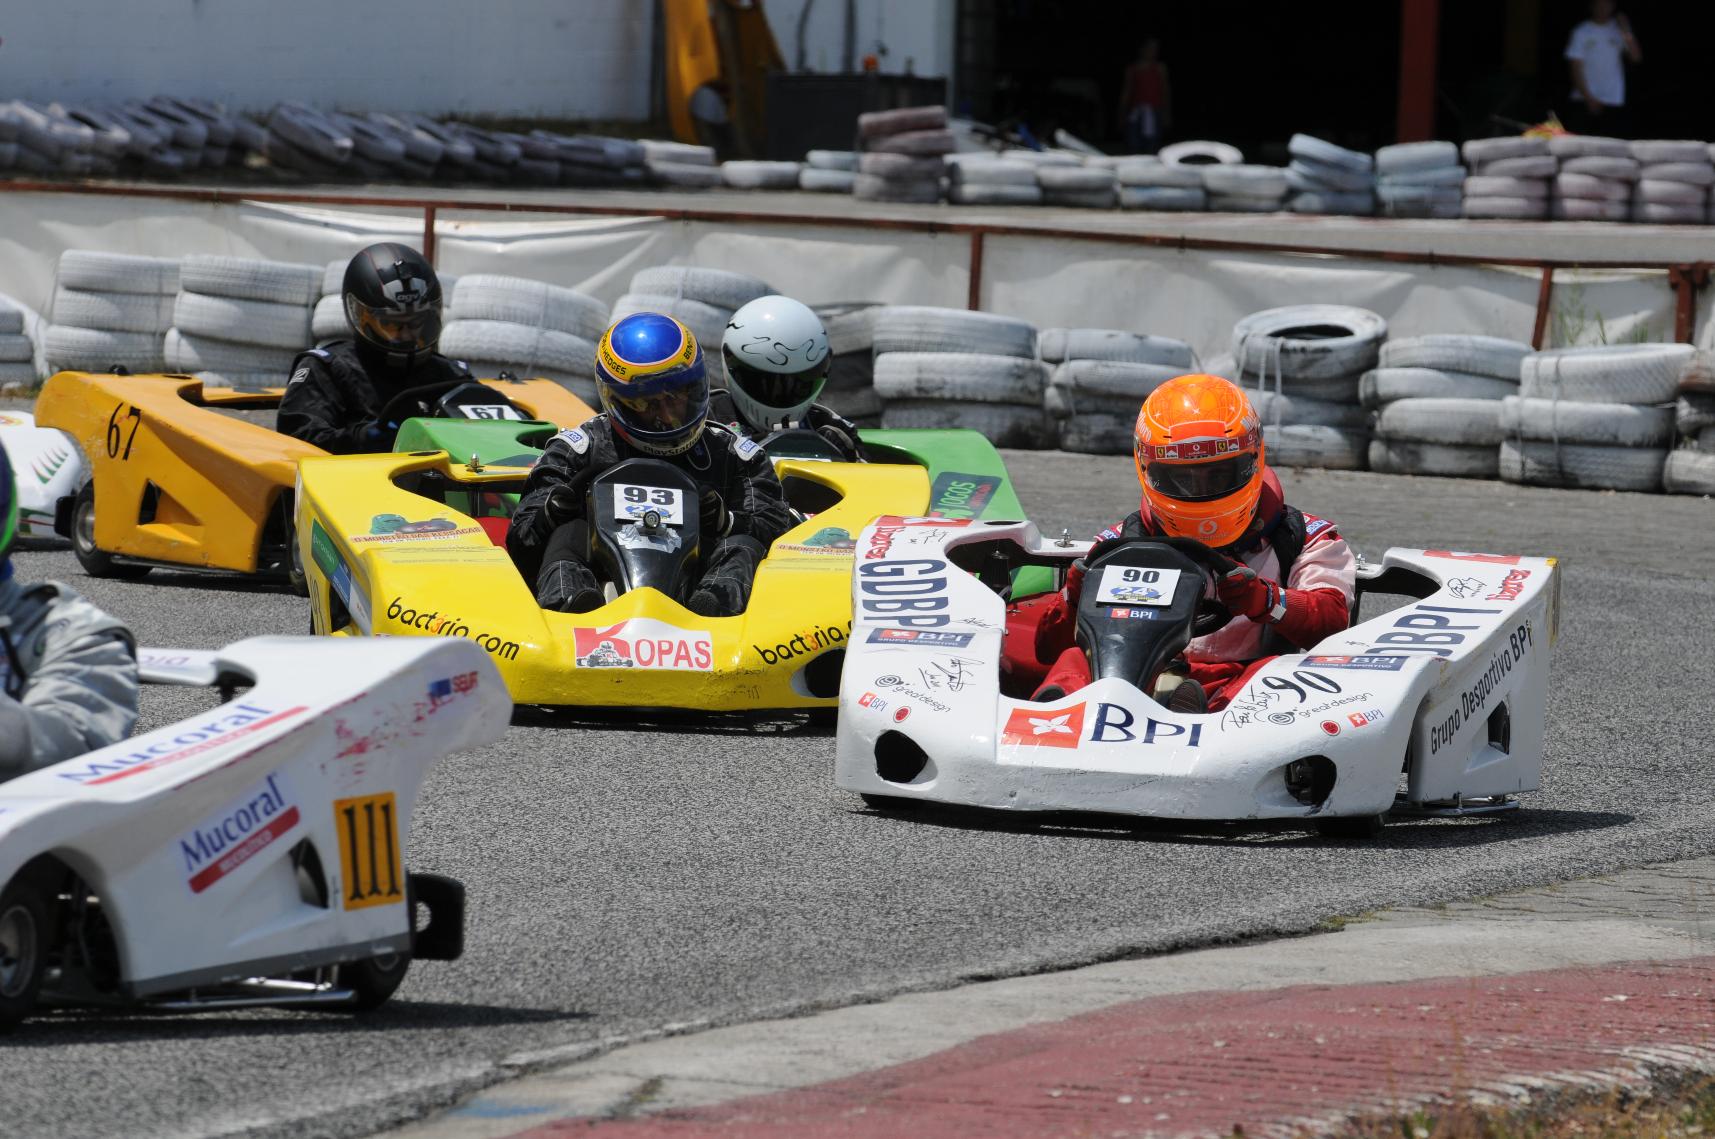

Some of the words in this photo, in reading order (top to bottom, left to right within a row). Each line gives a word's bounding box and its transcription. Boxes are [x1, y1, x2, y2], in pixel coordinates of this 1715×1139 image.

[471, 406, 505, 420] 67
[107, 402, 141, 461] 67
[624, 486, 674, 505] 93
[1122, 568, 1160, 584] 90
[1130, 610, 1153, 619] BPI
[918, 631, 963, 642] BPI
[1351, 656, 1398, 664] BPI
[1262, 670, 1342, 703] 90
[870, 697, 889, 712] BPI
[1431, 708, 1460, 755] Grupo
[1461, 650, 1512, 722] Desportivo
[1365, 708, 1385, 722] BPI
[1089, 702, 1205, 748] BPI
[57, 700, 273, 783] Mucoral
[180, 770, 285, 872] Mucoral
[343, 800, 402, 902] 111
